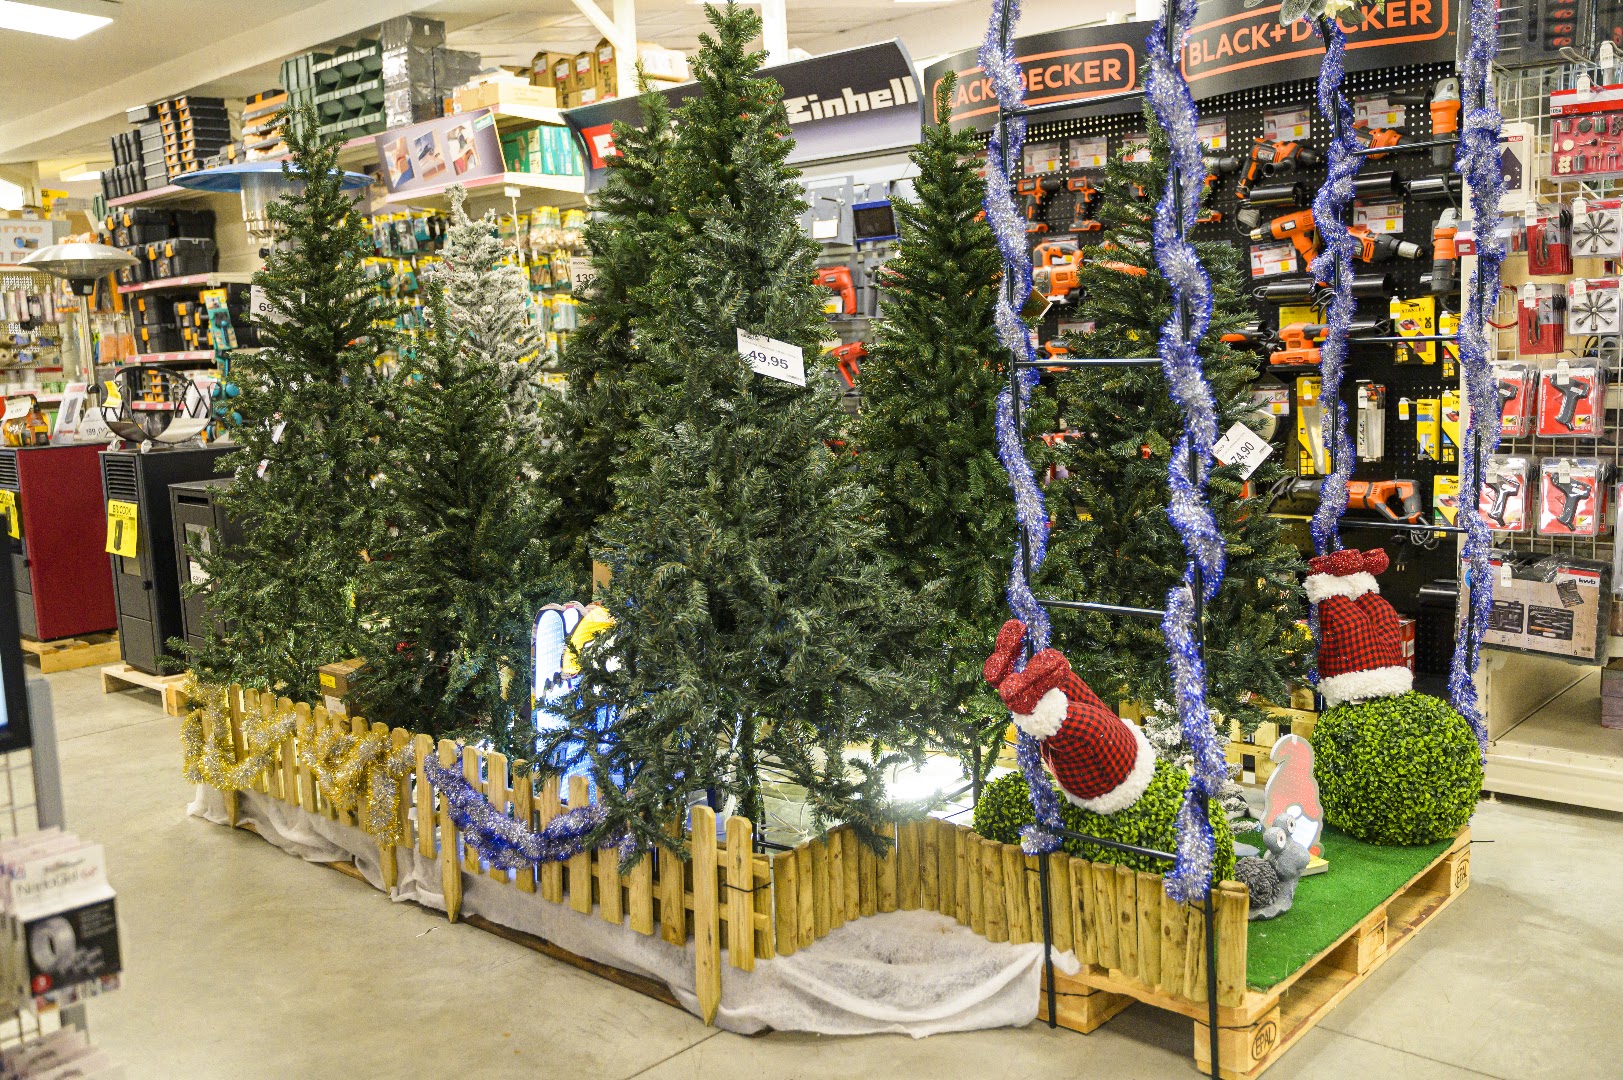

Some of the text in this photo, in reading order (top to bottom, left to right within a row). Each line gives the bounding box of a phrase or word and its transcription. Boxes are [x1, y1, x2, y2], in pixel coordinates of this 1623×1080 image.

[1189, 2, 1432, 67] BLACK+DCKER
[946, 58, 1122, 108] ACKECKER
[783, 76, 918, 124] Einhell
[749, 350, 789, 370] 49,95
[1231, 441, 1255, 463] 74,90
[1578, 577, 1596, 585] kwb
[1255, 1027, 1273, 1056] EPAL
